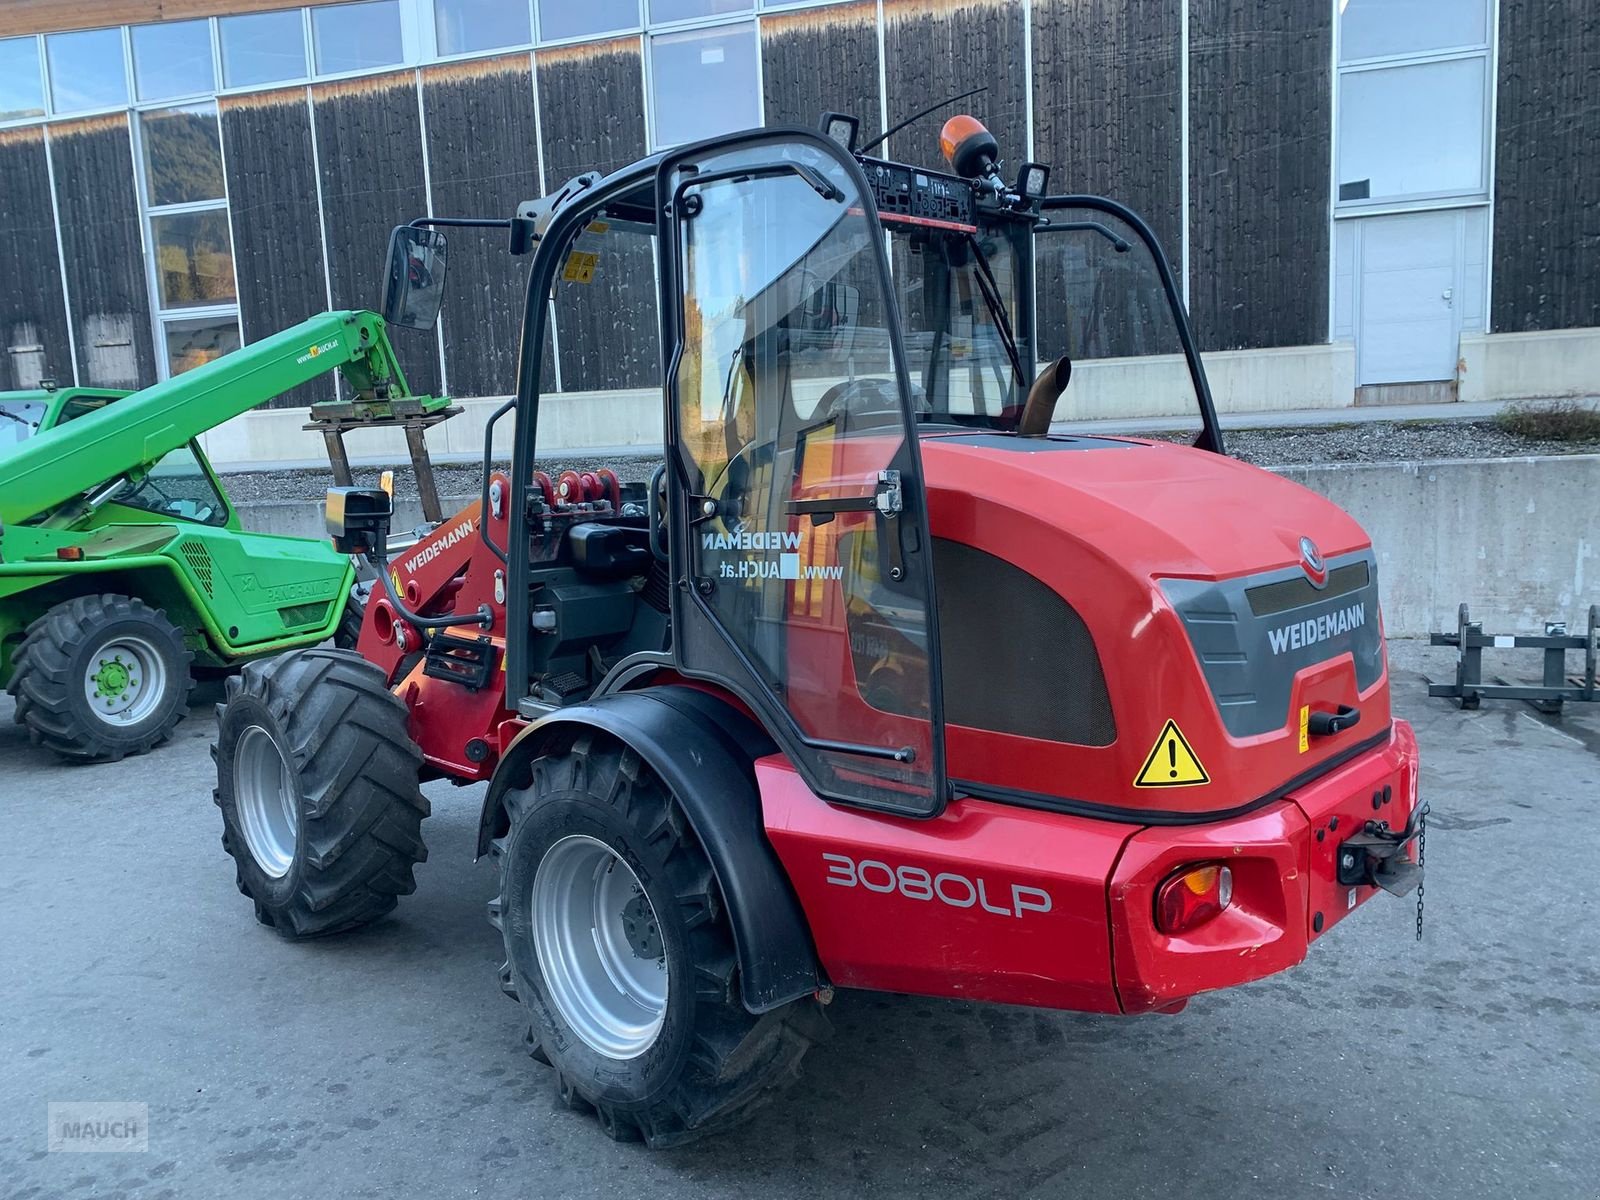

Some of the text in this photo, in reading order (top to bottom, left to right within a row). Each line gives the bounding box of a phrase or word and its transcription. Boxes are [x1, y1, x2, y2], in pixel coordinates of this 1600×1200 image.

[404, 519, 474, 574] WEIDEMANN
[1268, 602, 1365, 655] WEIDEMANN
[822, 852, 1052, 918] 3080LP
